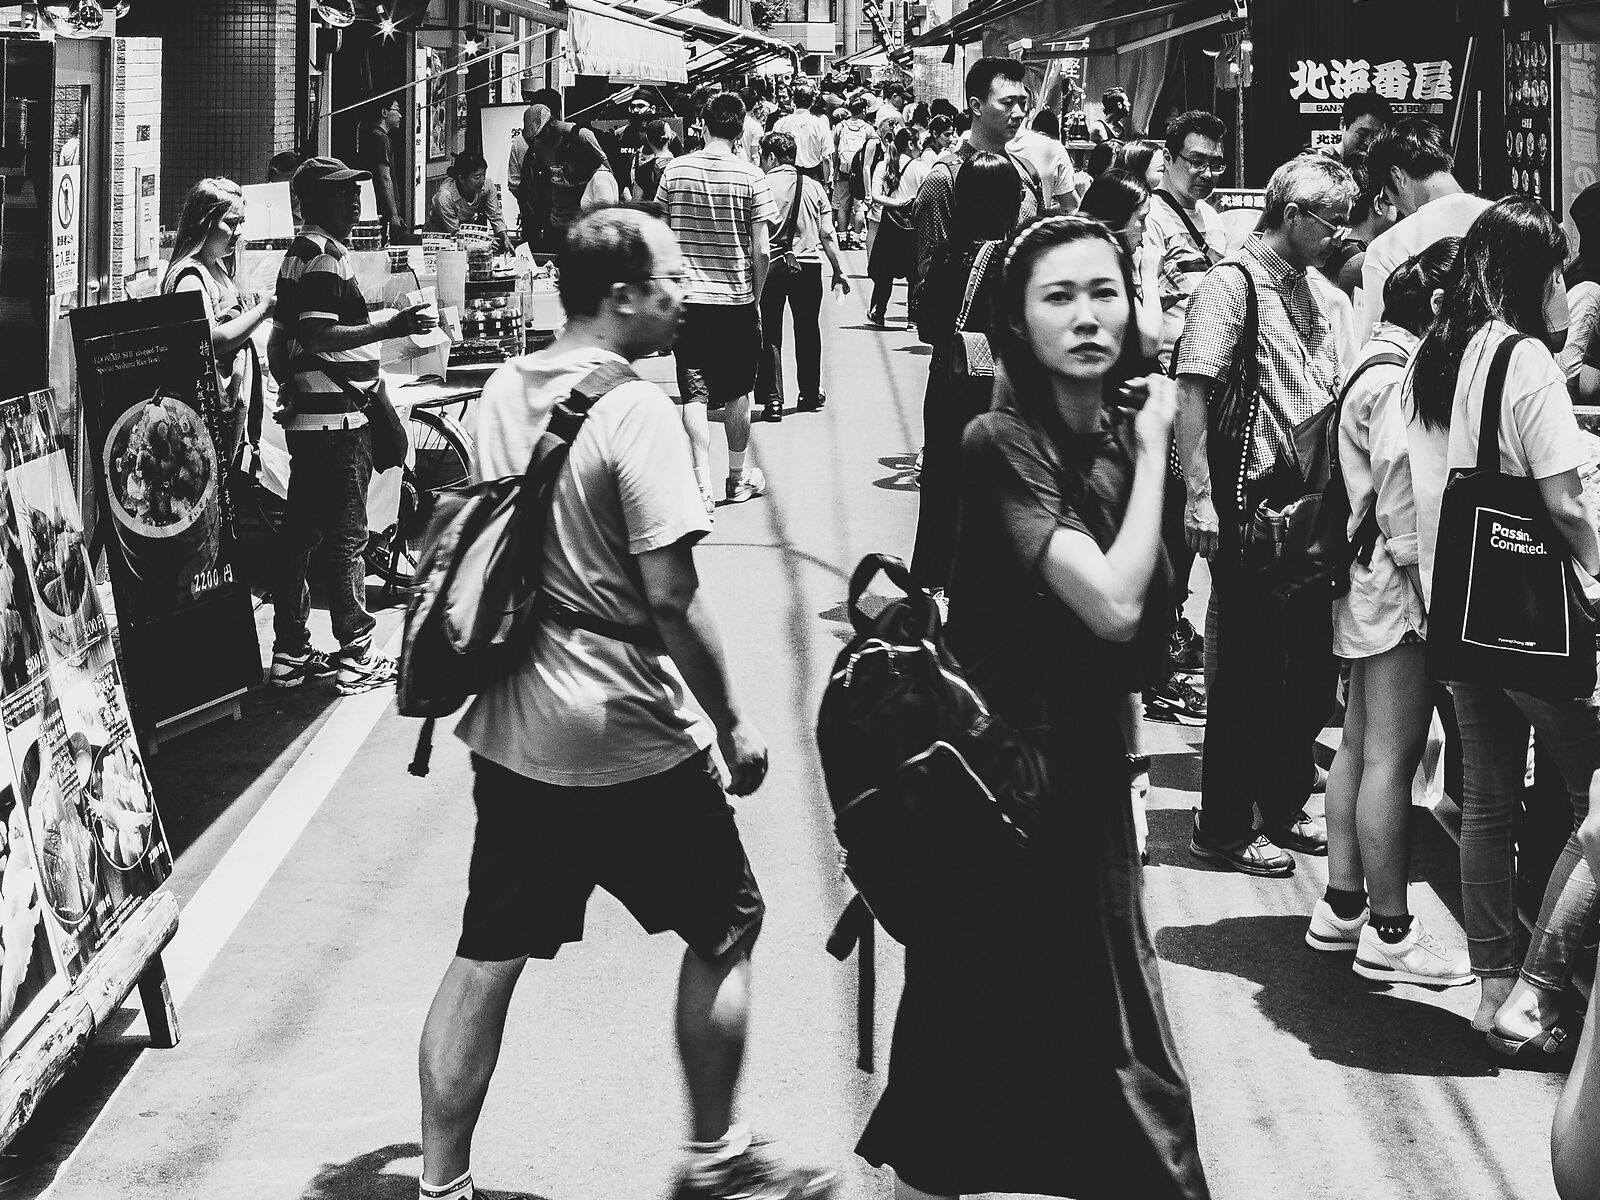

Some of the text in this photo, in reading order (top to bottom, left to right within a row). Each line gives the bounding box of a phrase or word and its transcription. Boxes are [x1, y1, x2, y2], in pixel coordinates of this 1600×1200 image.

[1290, 58, 1454, 101] 北海番屋
[194, 563, 234, 591] 2200 円
